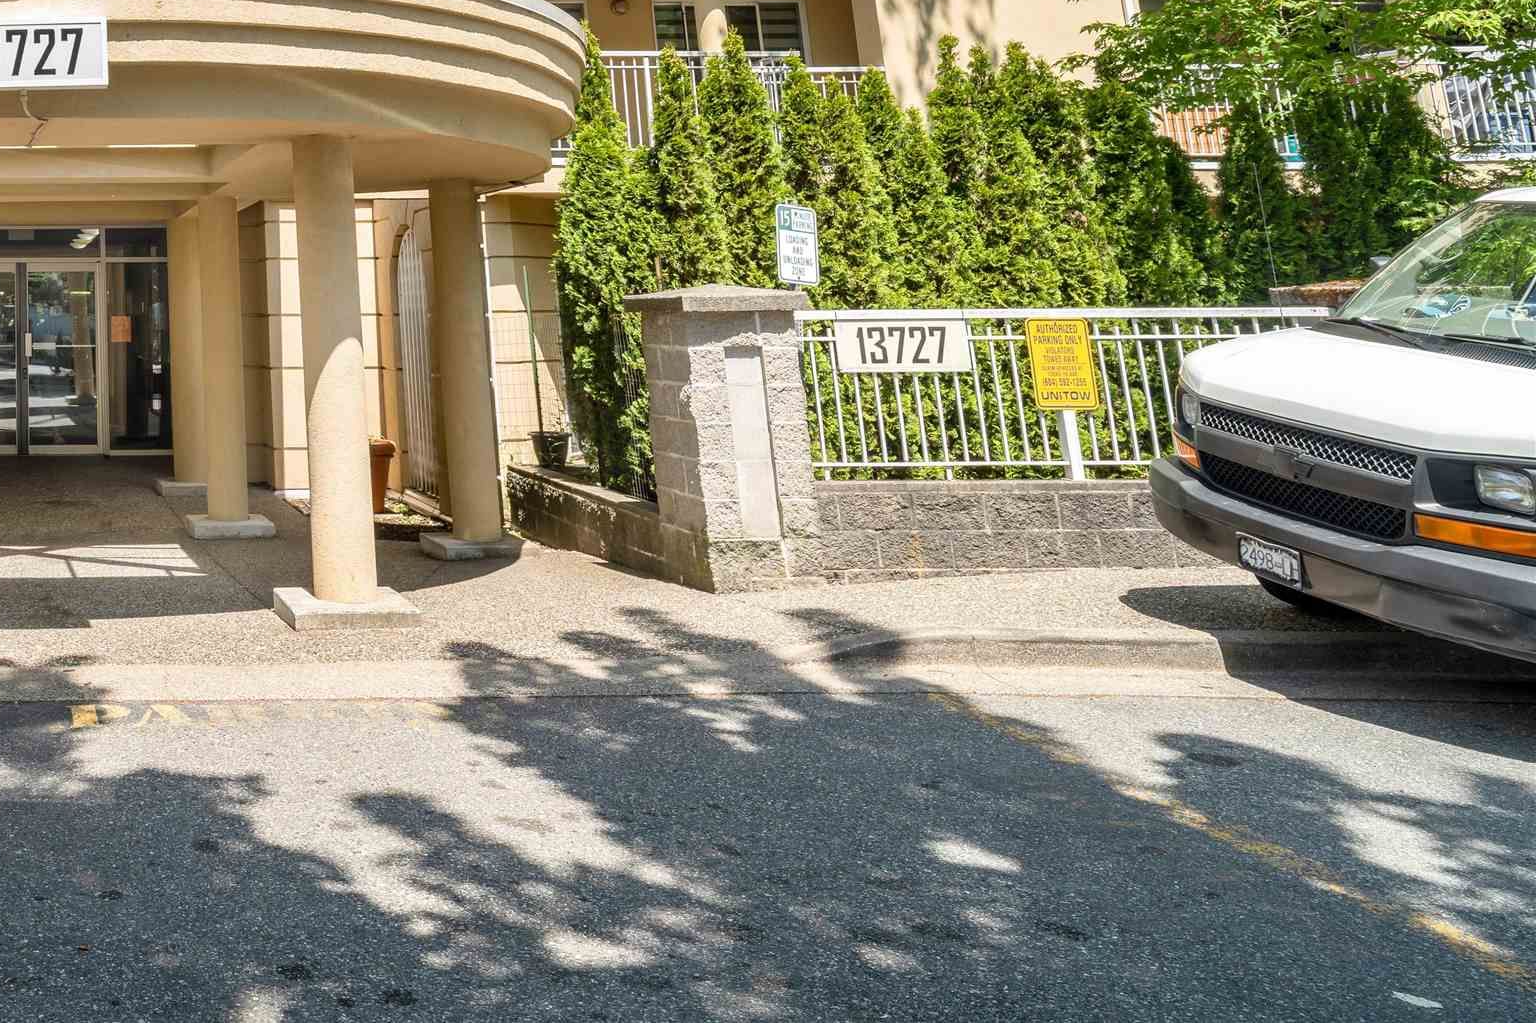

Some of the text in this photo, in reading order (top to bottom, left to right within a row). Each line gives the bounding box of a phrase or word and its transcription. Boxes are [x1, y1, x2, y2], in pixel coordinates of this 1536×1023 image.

[780, 209, 791, 225] 15
[1036, 322, 1078, 334] AUTHORIZED
[856, 326, 946, 364] 13727
[1033, 335, 1082, 345] PARKING ONLY
[1041, 391, 1090, 400] UNITOW
